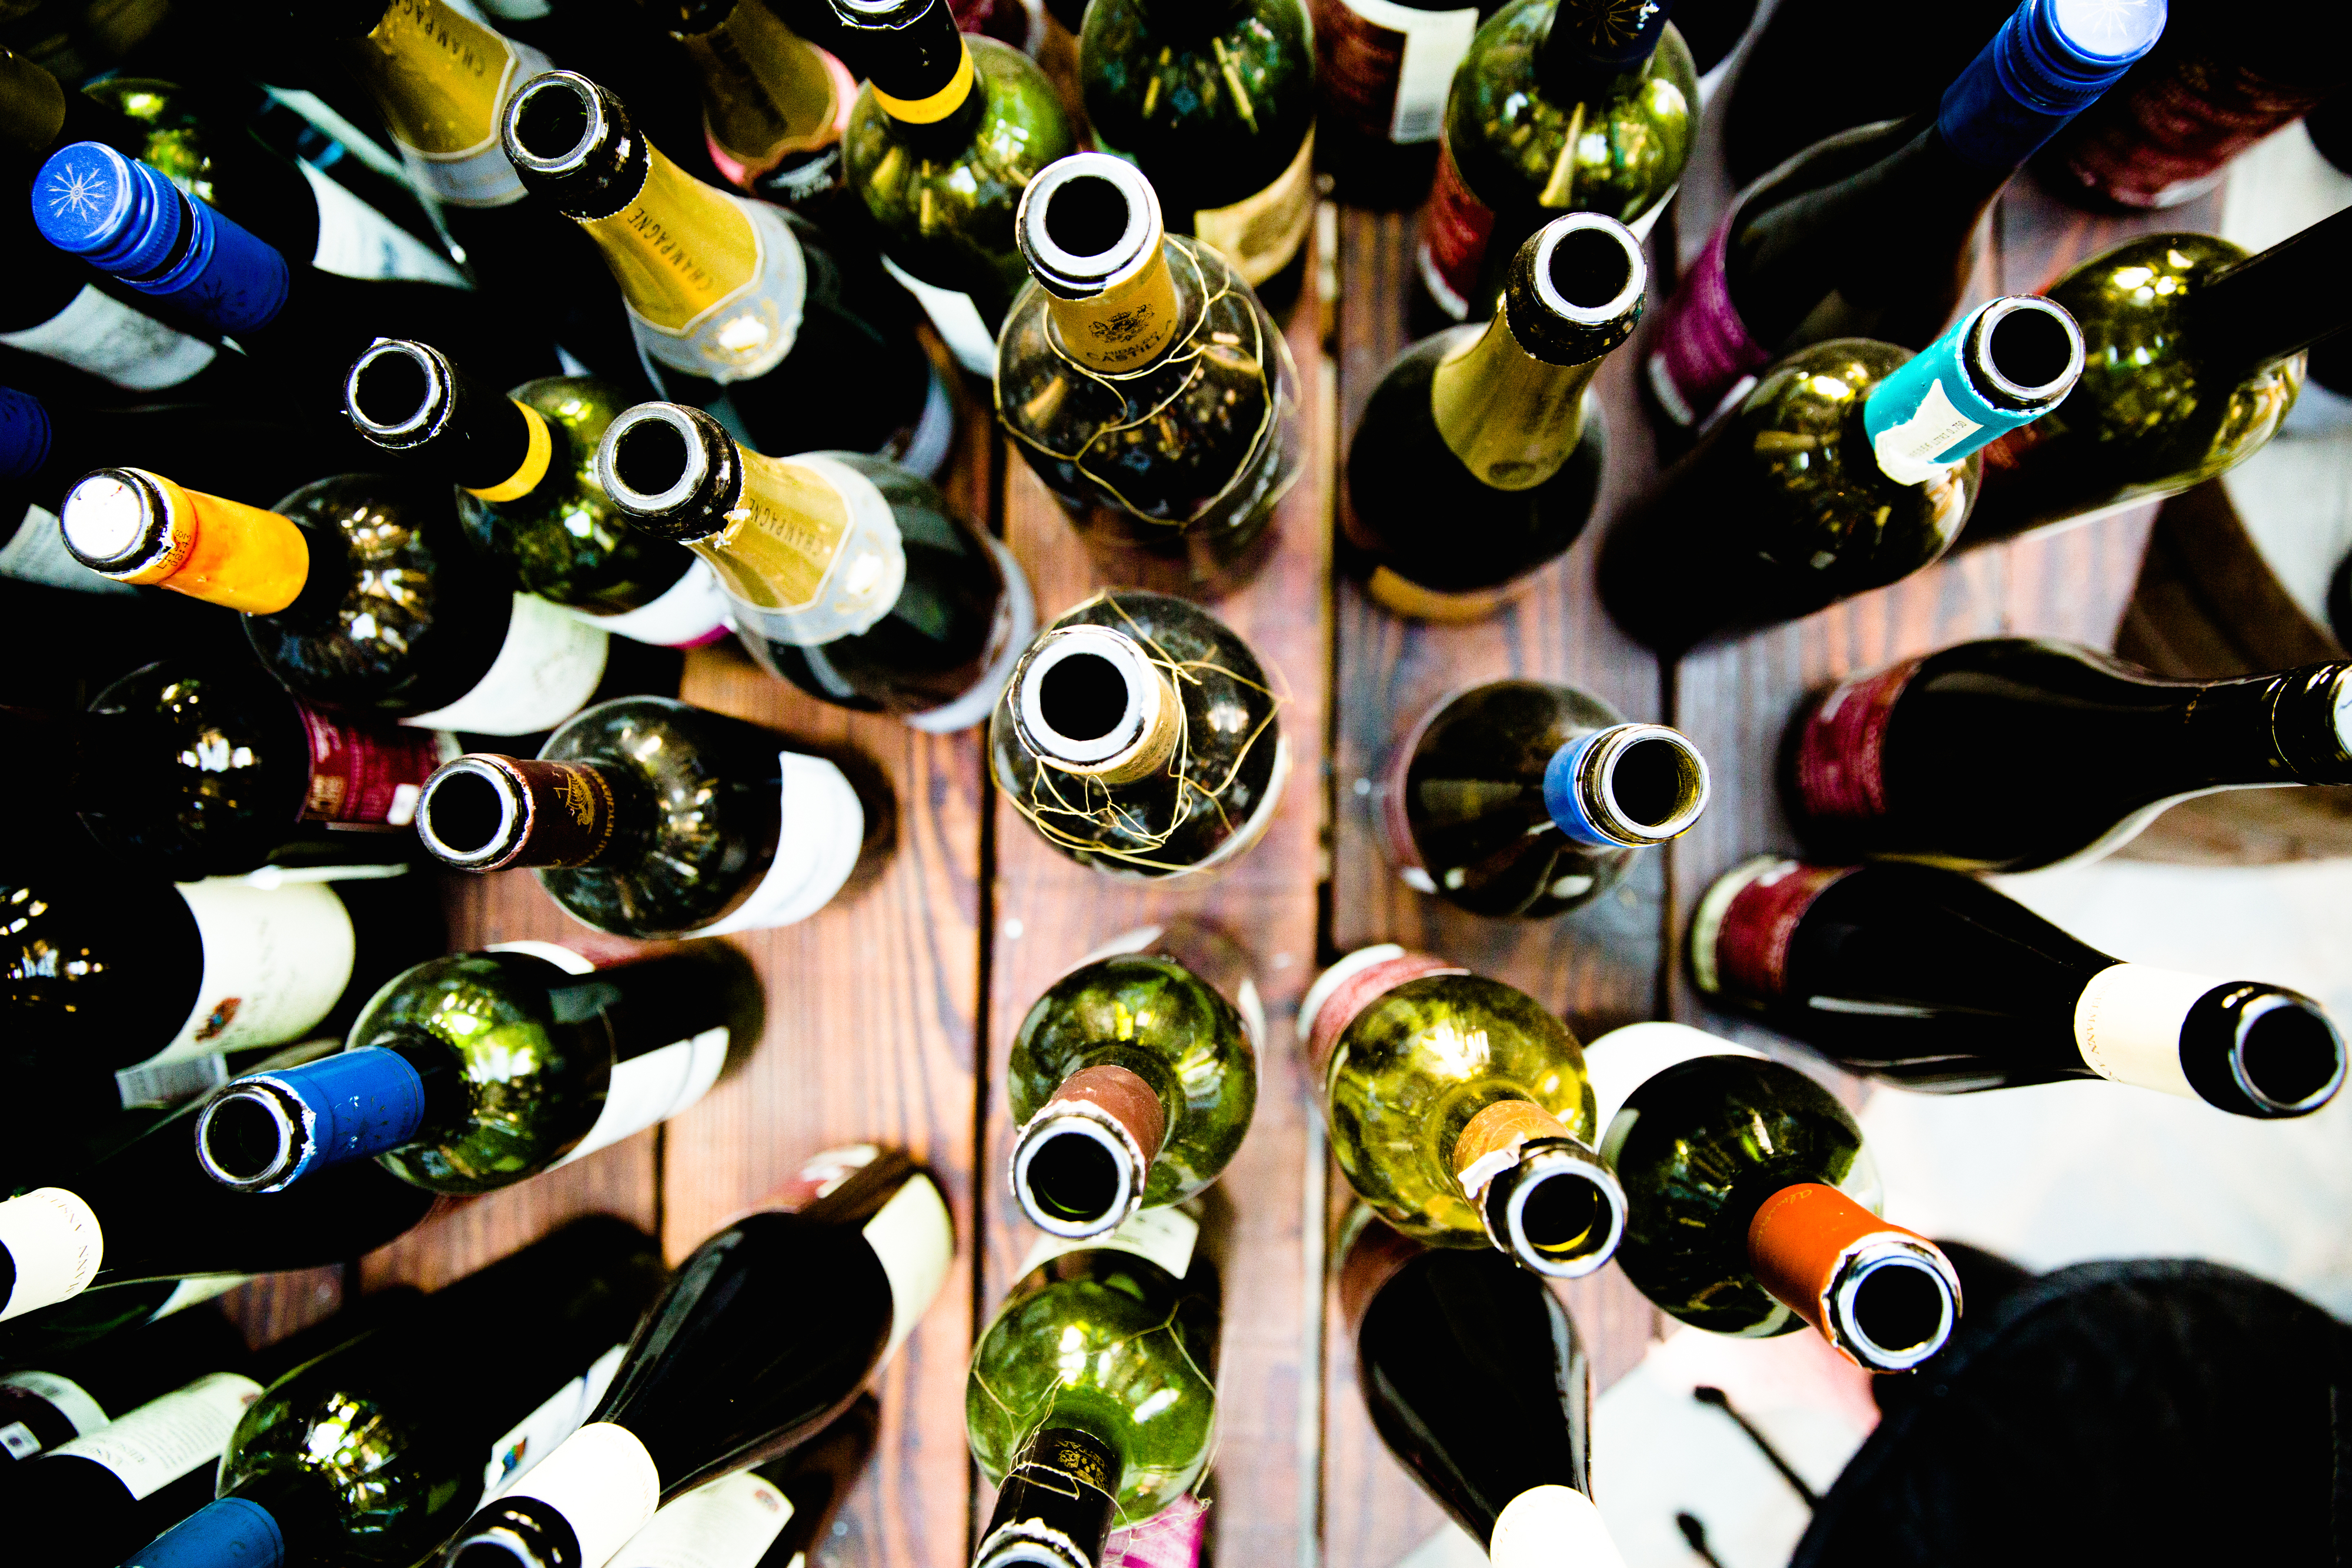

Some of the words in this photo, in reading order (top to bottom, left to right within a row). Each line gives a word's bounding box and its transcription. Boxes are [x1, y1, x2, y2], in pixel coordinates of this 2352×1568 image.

[395, 0, 486, 76] CHAMPAG
[627, 208, 714, 292] CHAMPAGNE
[1946, 420, 1967, 434] 0.750
[749, 498, 824, 556] CHAMPAGNE
